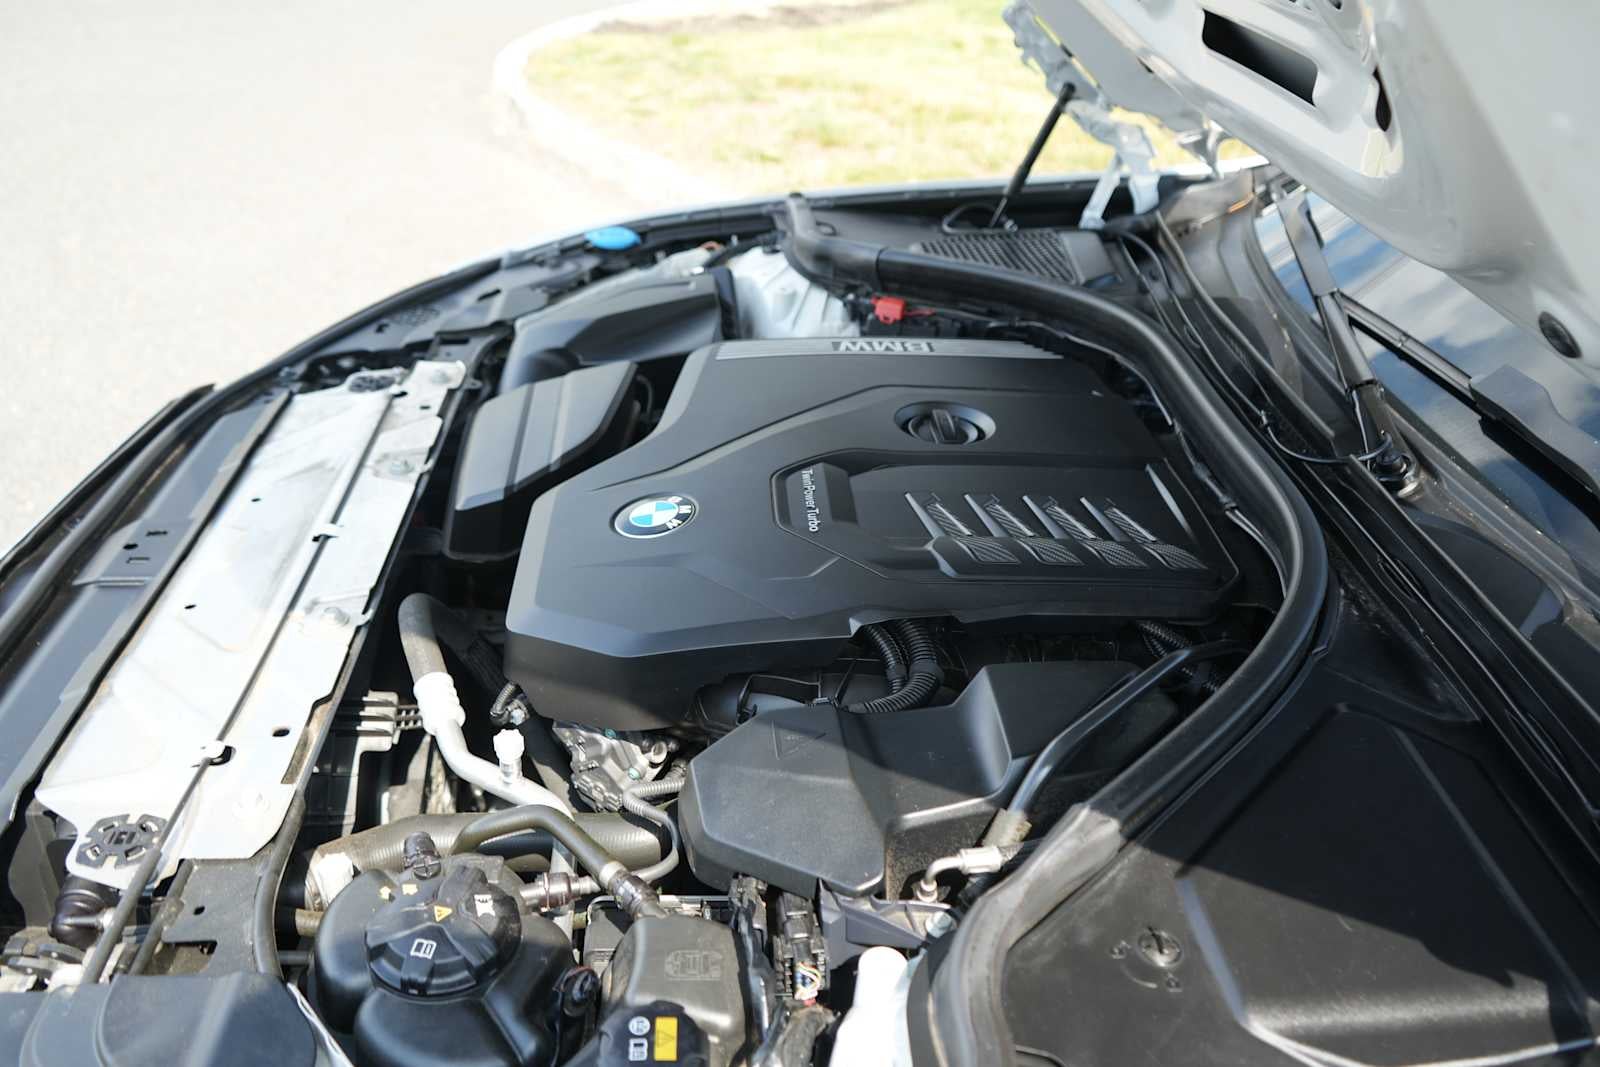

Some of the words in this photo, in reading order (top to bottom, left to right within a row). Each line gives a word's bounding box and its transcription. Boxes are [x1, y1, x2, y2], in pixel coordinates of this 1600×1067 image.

[837, 341, 931, 353] BMW
[801, 469, 816, 508] TwinPower
[807, 508, 821, 532] Turbo
